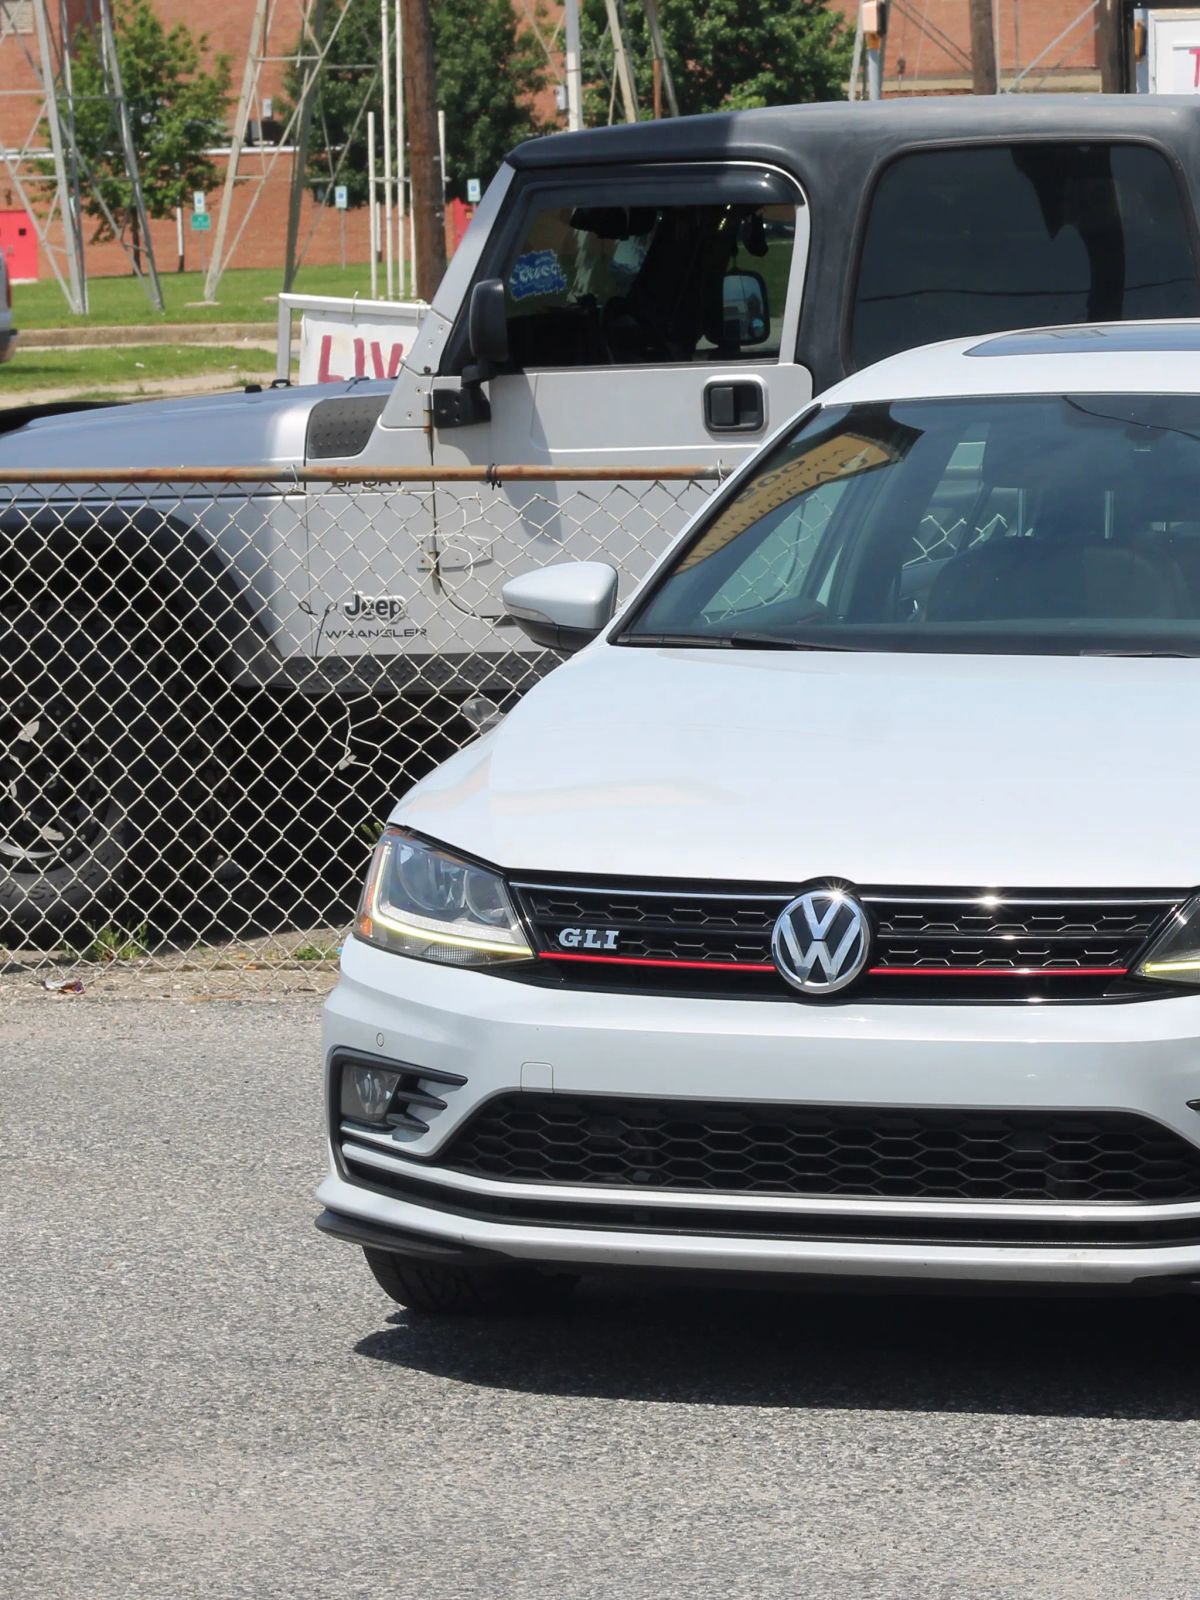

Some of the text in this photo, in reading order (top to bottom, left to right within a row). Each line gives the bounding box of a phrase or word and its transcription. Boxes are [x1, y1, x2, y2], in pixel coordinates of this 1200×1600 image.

[344, 592, 405, 621] Jeep
[325, 628, 427, 639] WRANGLER
[558, 928, 620, 949] GLI
[777, 895, 865, 986] VW
